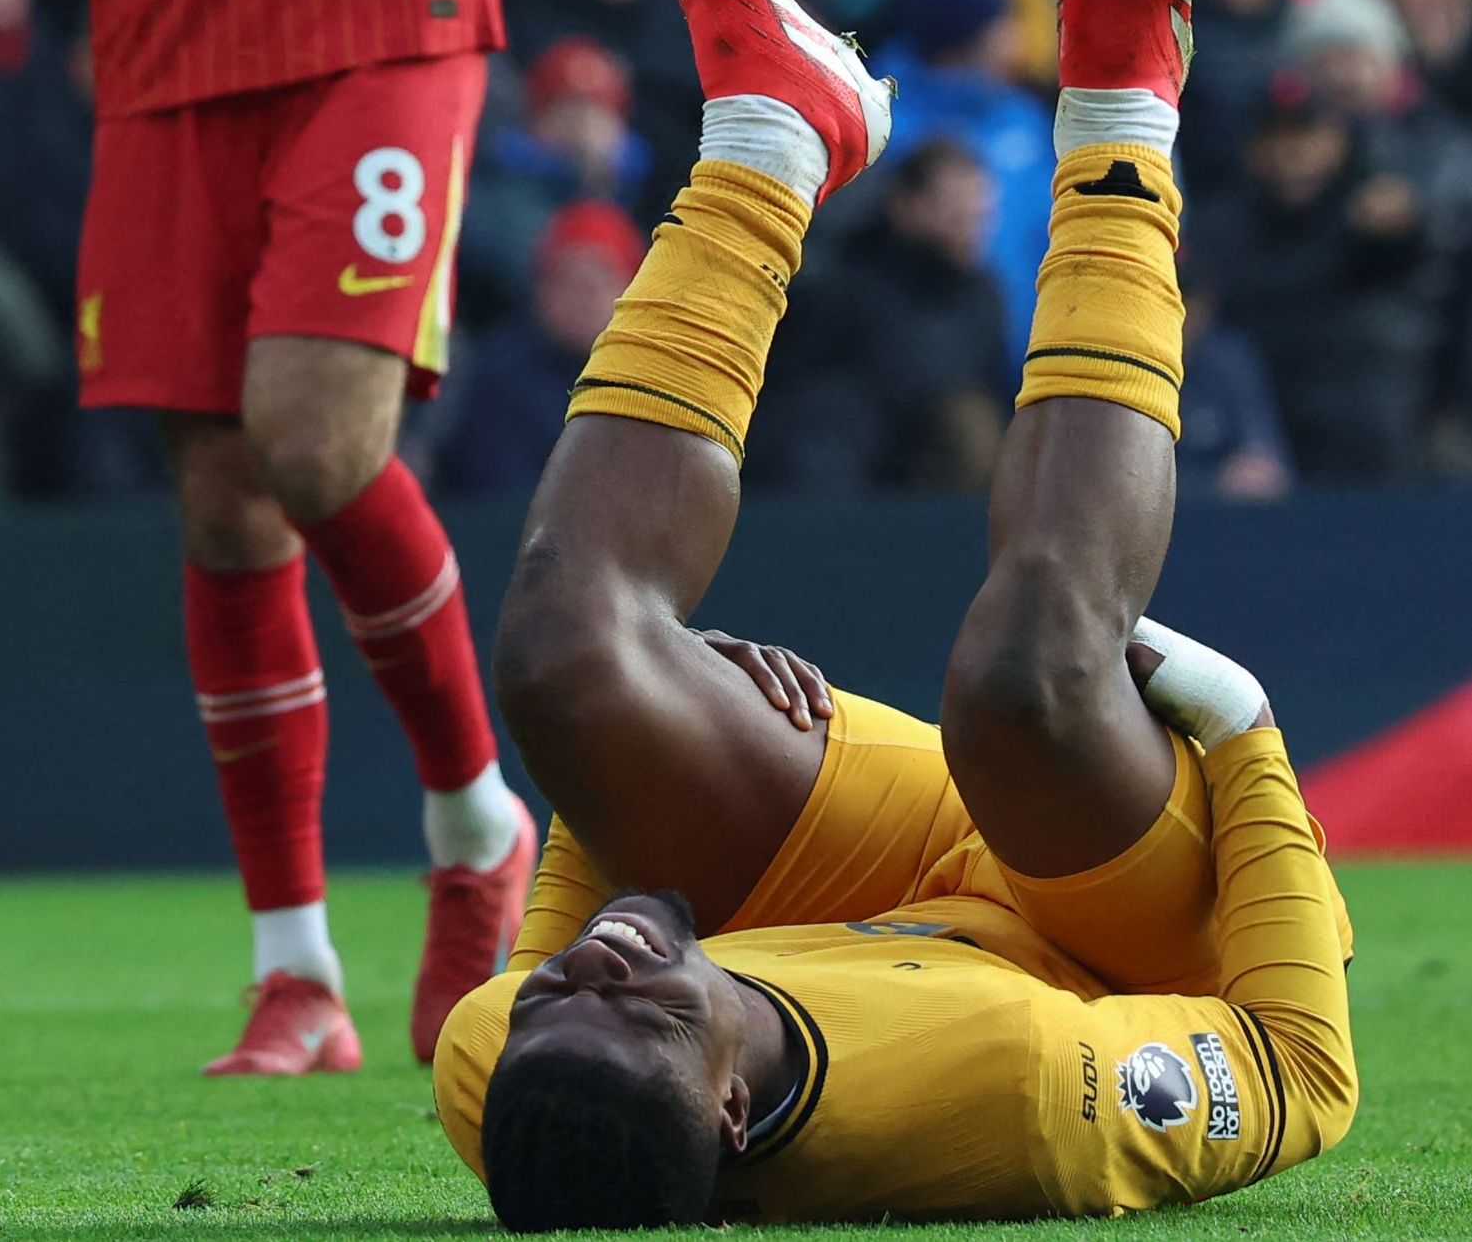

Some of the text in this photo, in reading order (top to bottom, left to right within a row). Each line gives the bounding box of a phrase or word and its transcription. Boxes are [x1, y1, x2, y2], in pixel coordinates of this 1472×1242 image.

[353, 146, 426, 264] 8
[1078, 1041, 1098, 1125] SUDU
[1196, 1042, 1226, 1139] No room
[1222, 1105, 1240, 1139] for
